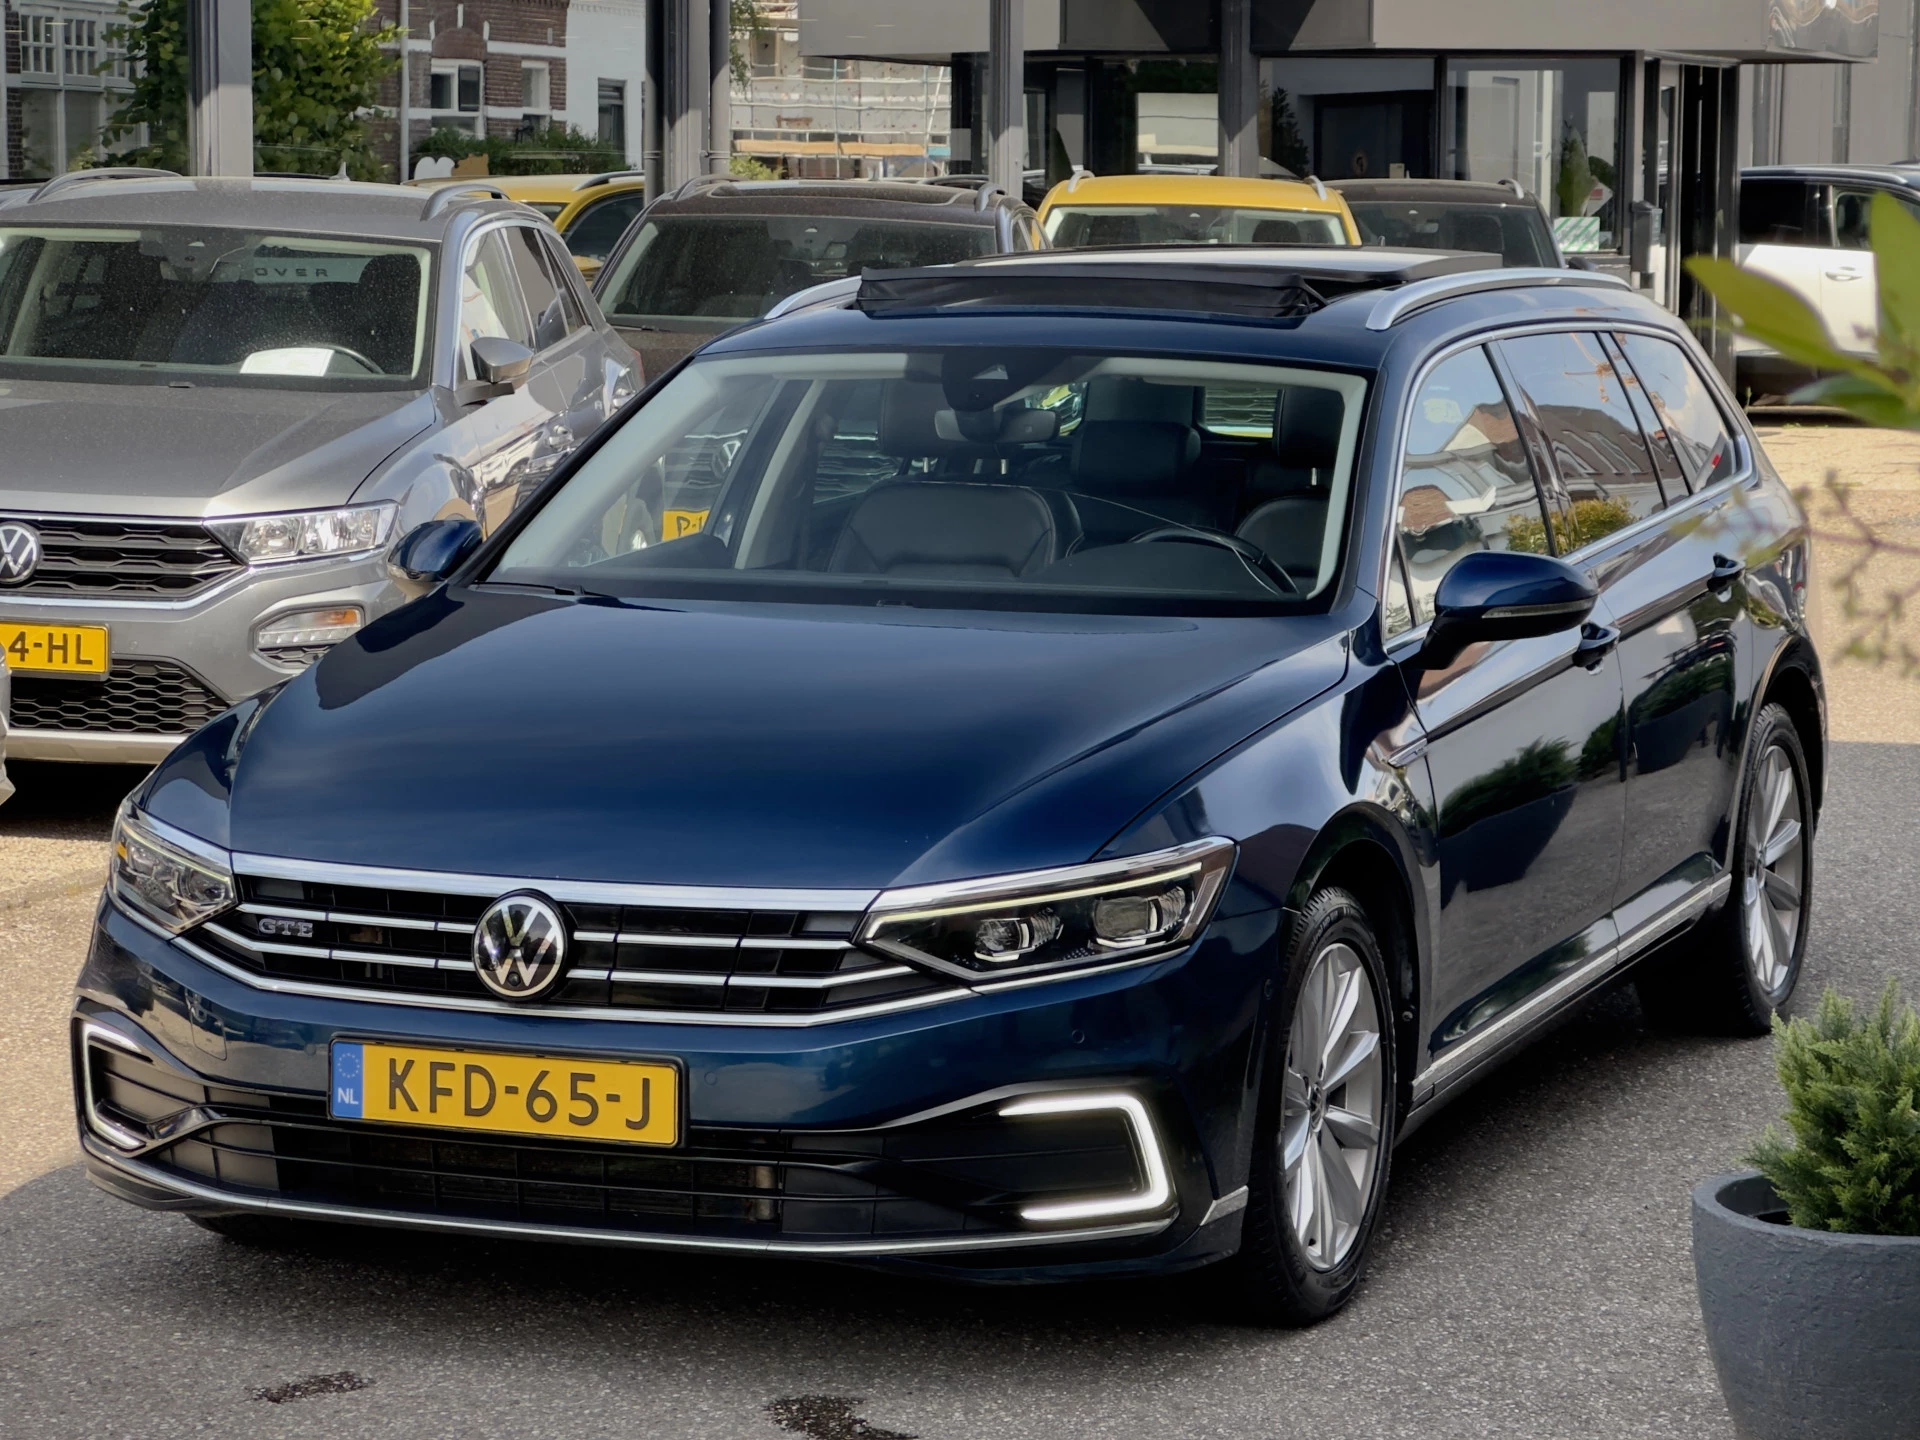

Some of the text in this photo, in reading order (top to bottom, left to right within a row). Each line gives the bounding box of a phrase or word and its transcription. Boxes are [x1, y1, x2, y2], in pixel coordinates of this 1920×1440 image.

[254, 267, 329, 277] OVER
[8, 631, 94, 666] 4-HL
[258, 918, 314, 938] GTE
[474, 895, 562, 997] VW
[337, 1088, 359, 1105] NL
[388, 1057, 651, 1130] KFD-65-J
